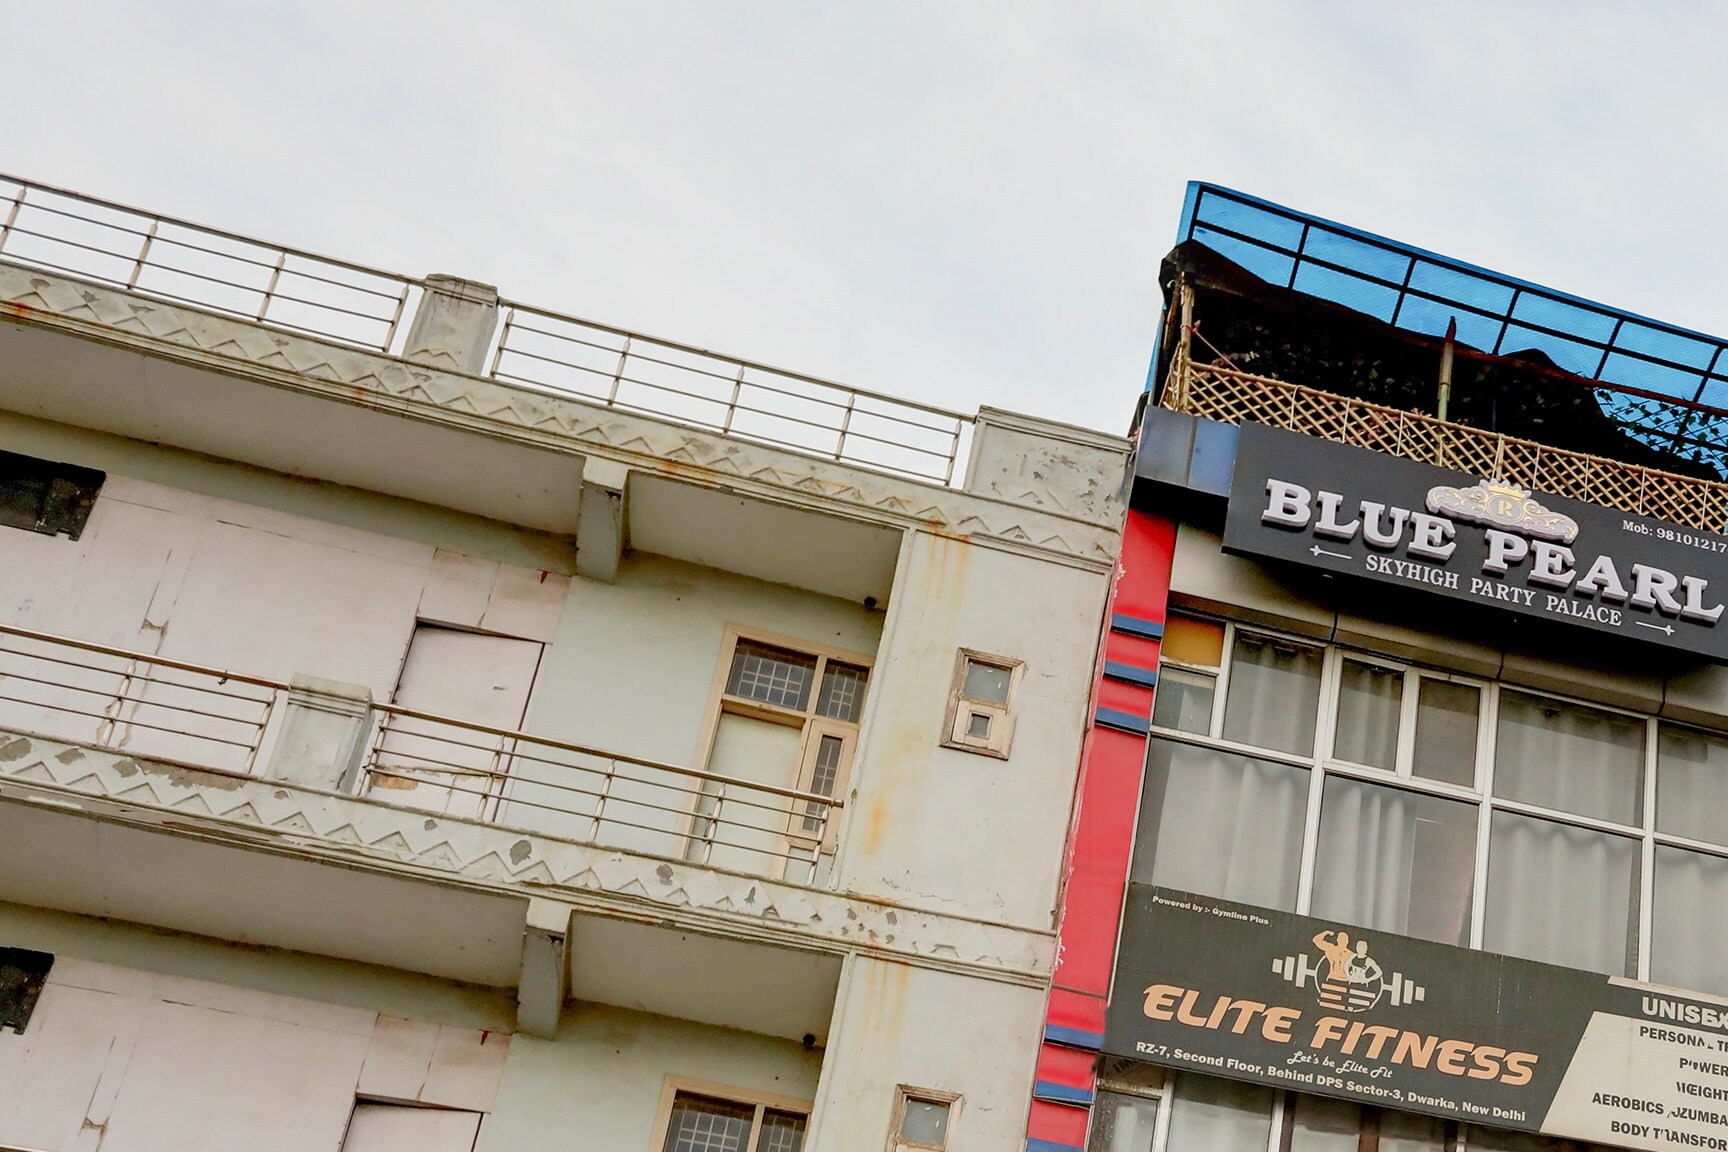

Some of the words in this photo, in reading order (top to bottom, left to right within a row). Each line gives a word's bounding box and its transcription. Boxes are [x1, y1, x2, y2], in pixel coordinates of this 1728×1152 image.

[1622, 520, 1653, 535] Mob:
[1261, 478, 1458, 560] BLUE
[1482, 529, 1725, 624] PEARL
[1366, 555, 1459, 589] SKYHIGH
[1470, 577, 1537, 607] PARTY
[1546, 595, 1622, 626] PALACE
[1152, 895, 1191, 910] Powered
[1193, 902, 1203, 913] by
[1212, 907, 1248, 921] Gymline
[1249, 914, 1269, 925] Plus
[1143, 983, 1302, 1043] ELITE
[1310, 1015, 1539, 1086] FITNESS
[1287, 1050, 1320, 1065] Let's
[1322, 1056, 1335, 1068] be
[1335, 1060, 1368, 1075] Elite
[1136, 1041, 1171, 1058] RZ-7,
[1173, 1049, 1223, 1067] Second
[1226, 1058, 1264, 1076] Floor,
[1268, 1066, 1313, 1084] Behind
[1316, 1075, 1344, 1089] DPS
[1346, 1080, 1404, 1102] Sector-3,
[1407, 1092, 1459, 1112] Dwarka,
[1462, 1102, 1489, 1116] New
[1492, 1106, 1526, 1122] Delhi
[1592, 1092, 1664, 1114] AEROBICS
[1611, 1120, 1650, 1137] BODY
